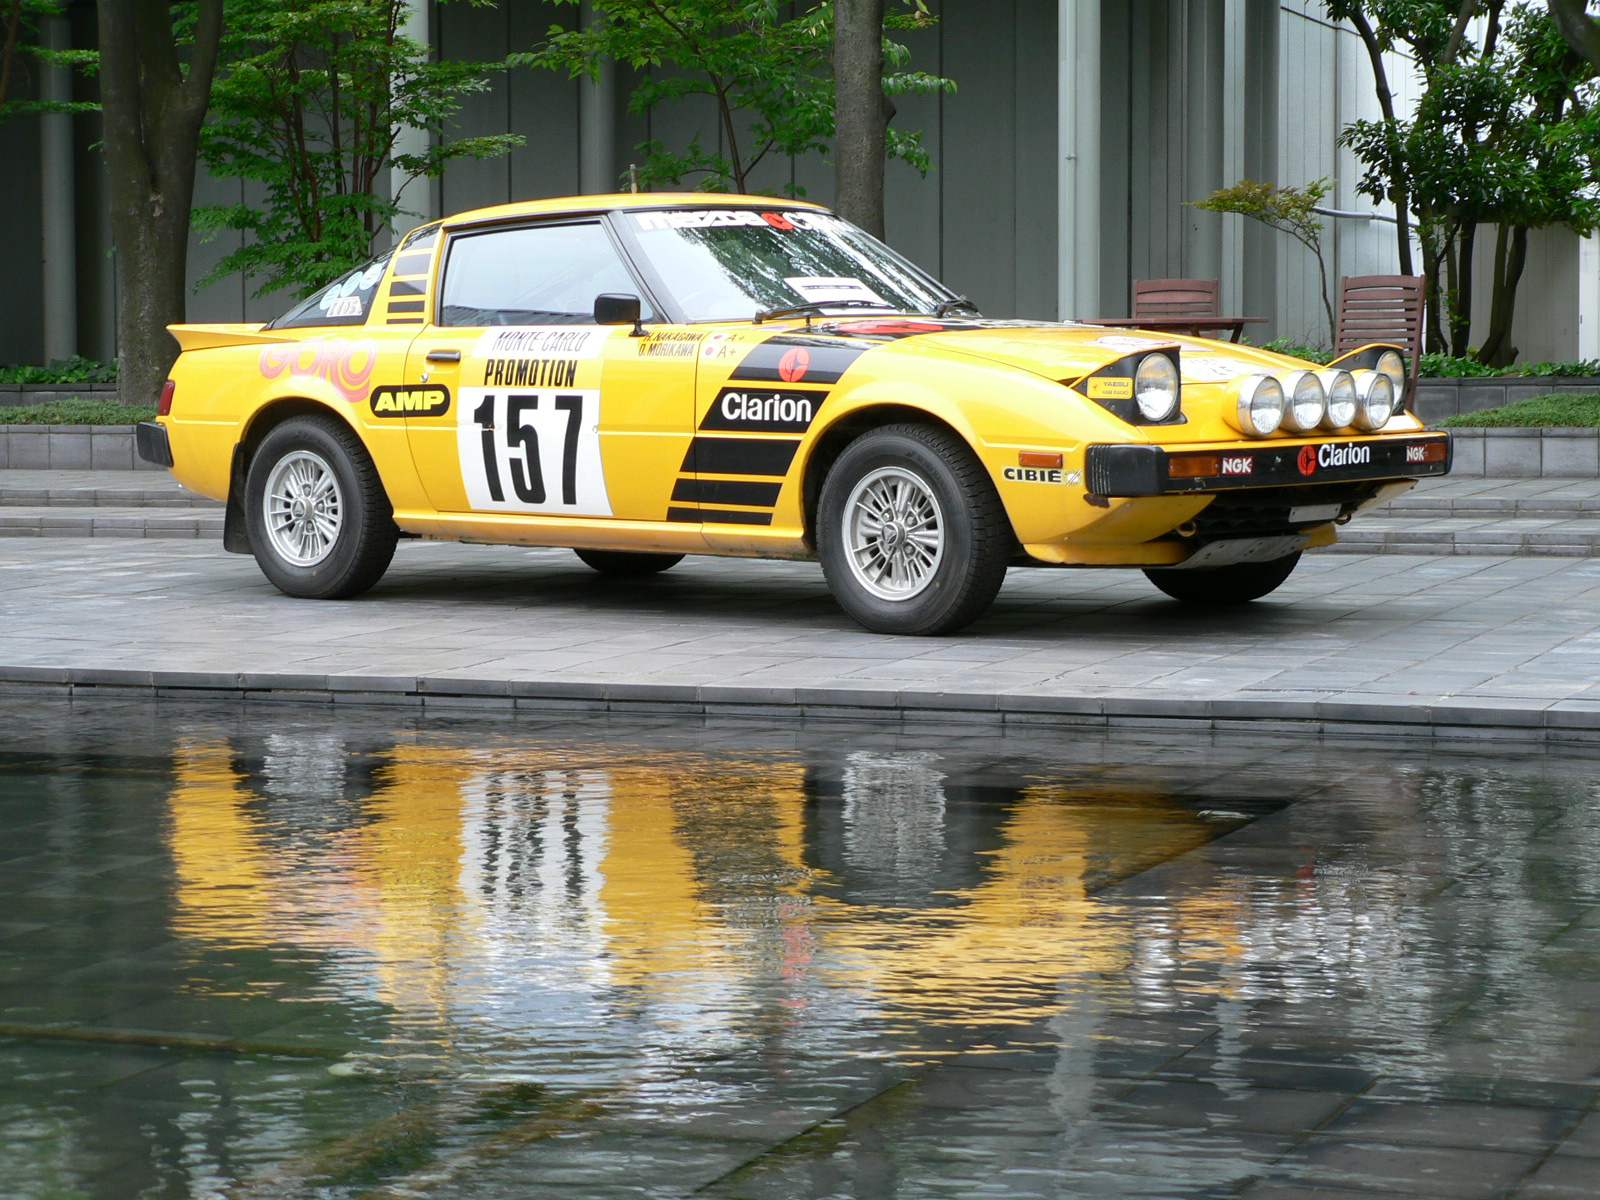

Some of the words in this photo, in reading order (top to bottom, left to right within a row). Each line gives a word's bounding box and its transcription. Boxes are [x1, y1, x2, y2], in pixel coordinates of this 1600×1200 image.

[634, 211, 769, 230] mazda
[655, 332, 704, 342] NAKAGAWA
[647, 343, 695, 357] MORIKAWA
[259, 338, 378, 403] GORO
[483, 358, 578, 388] PROMOTION
[374, 390, 445, 411] AMP
[721, 392, 812, 422] Clarion
[474, 394, 583, 505] 157
[1318, 443, 1370, 468] Clarion
[1406, 446, 1425, 462] NGK
[1222, 457, 1252, 474] NGK
